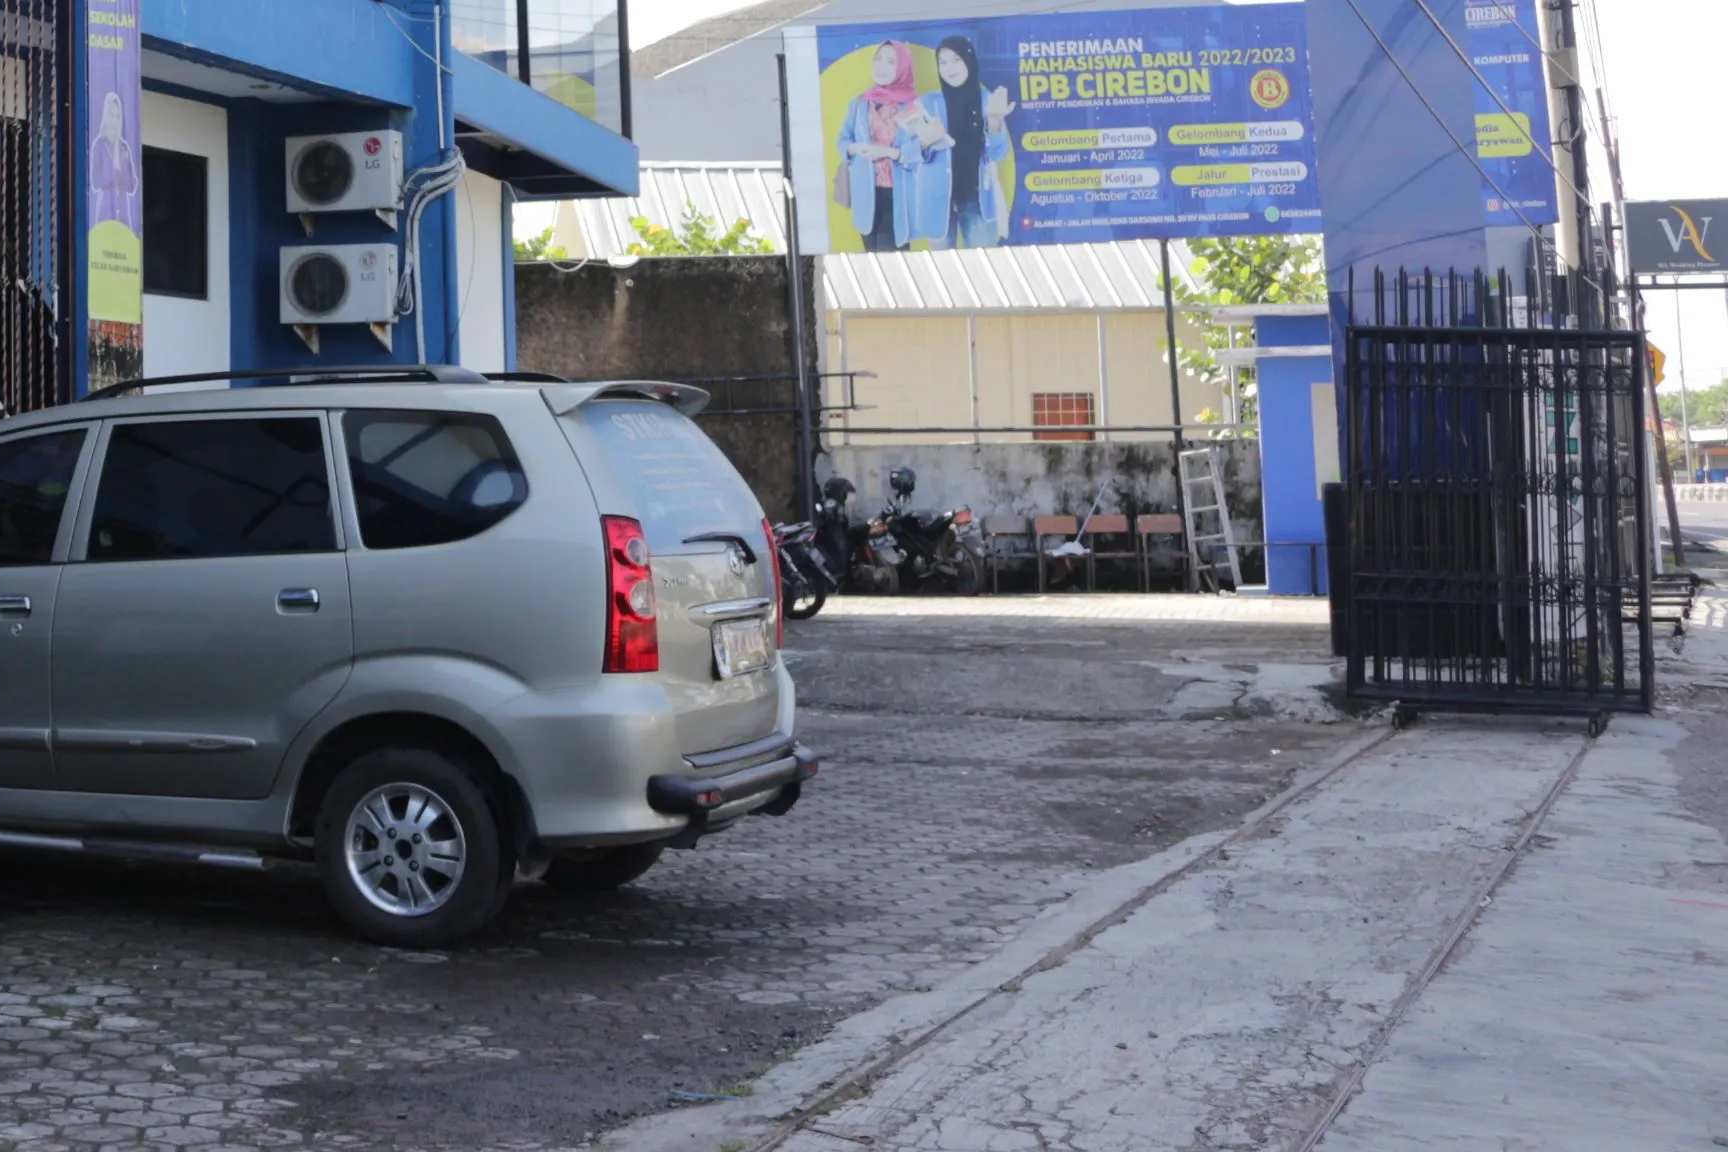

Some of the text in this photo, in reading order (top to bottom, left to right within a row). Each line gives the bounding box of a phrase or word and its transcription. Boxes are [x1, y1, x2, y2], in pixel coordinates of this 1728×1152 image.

[89, 10, 135, 28] SEKOLAH
[1019, 38, 1142, 57] PENERIMAAN
[1020, 47, 1296, 74] MAHASISWA BARU 2022/2023
[1474, 54, 1529, 65] KOMPUTER
[1020, 67, 1211, 102] IPB CIREBON
[1030, 132, 1151, 147] Gelombang Pertama
[1177, 126, 1287, 141] Gelombang Kedua
[1251, 144, 1278, 155] 2022
[365, 159, 380, 169] LG
[1040, 150, 1144, 164] Januari April 2022
[1033, 172, 1143, 188] Gelombang Ketiga
[1196, 166, 1300, 180] Jalur Prestasi
[1131, 189, 1158, 200] 2022
[1269, 184, 1296, 195] 2022
[361, 272, 376, 282] LG
